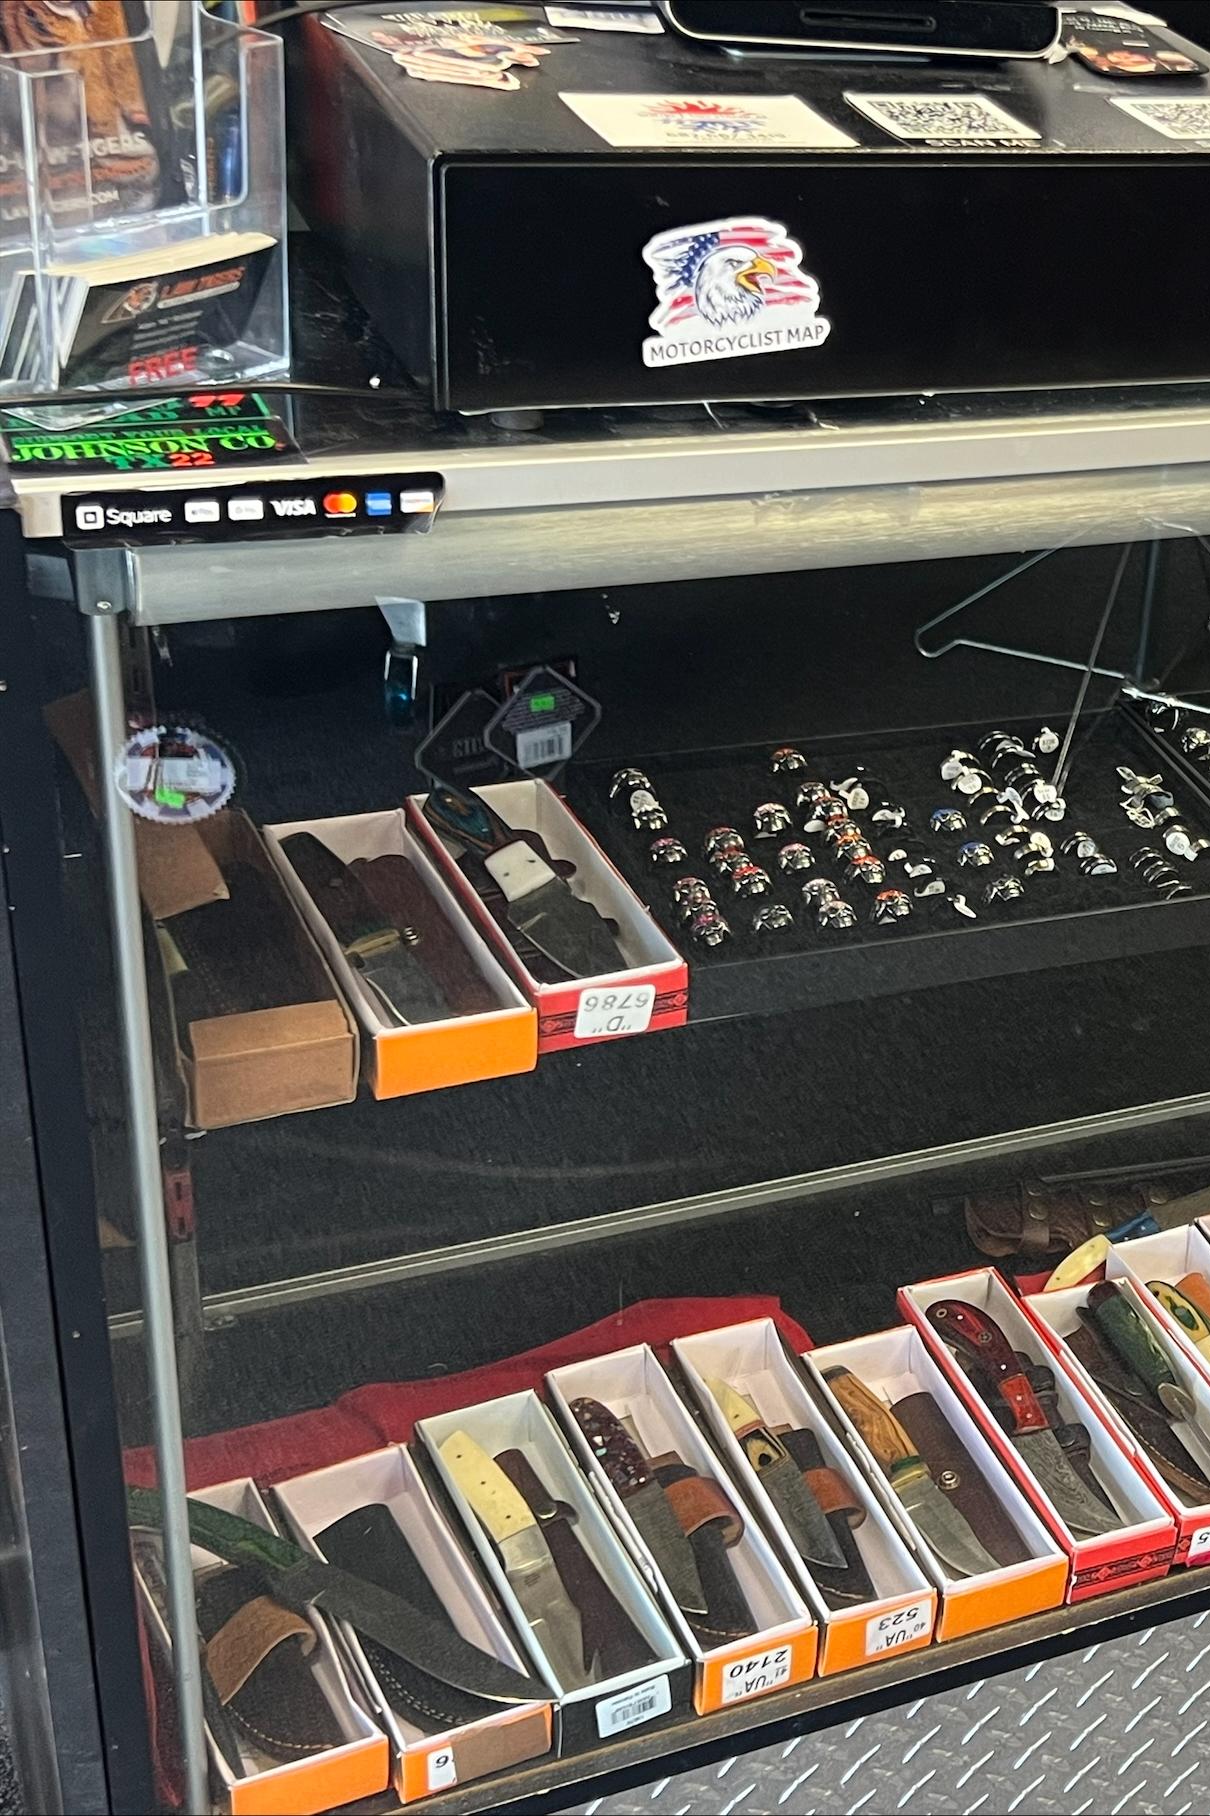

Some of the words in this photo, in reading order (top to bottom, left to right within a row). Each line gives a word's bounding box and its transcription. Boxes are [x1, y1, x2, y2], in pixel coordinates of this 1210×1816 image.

[924, 139, 997, 148] SCAN
[1000, 139, 1041, 148] ME
[650, 330, 783, 361] MOTORCYCLIST
[787, 324, 825, 344] MAP
[128, 347, 198, 385] FREE
[11, 436, 208, 462] JOHNSON
[219, 434, 277, 451] CO
[106, 508, 173, 529] Square
[269, 499, 317, 516] VISA
[583, 991, 650, 1012] 6786
[878, 1607, 919, 1631] 523
[729, 1649, 788, 1679] 2140
